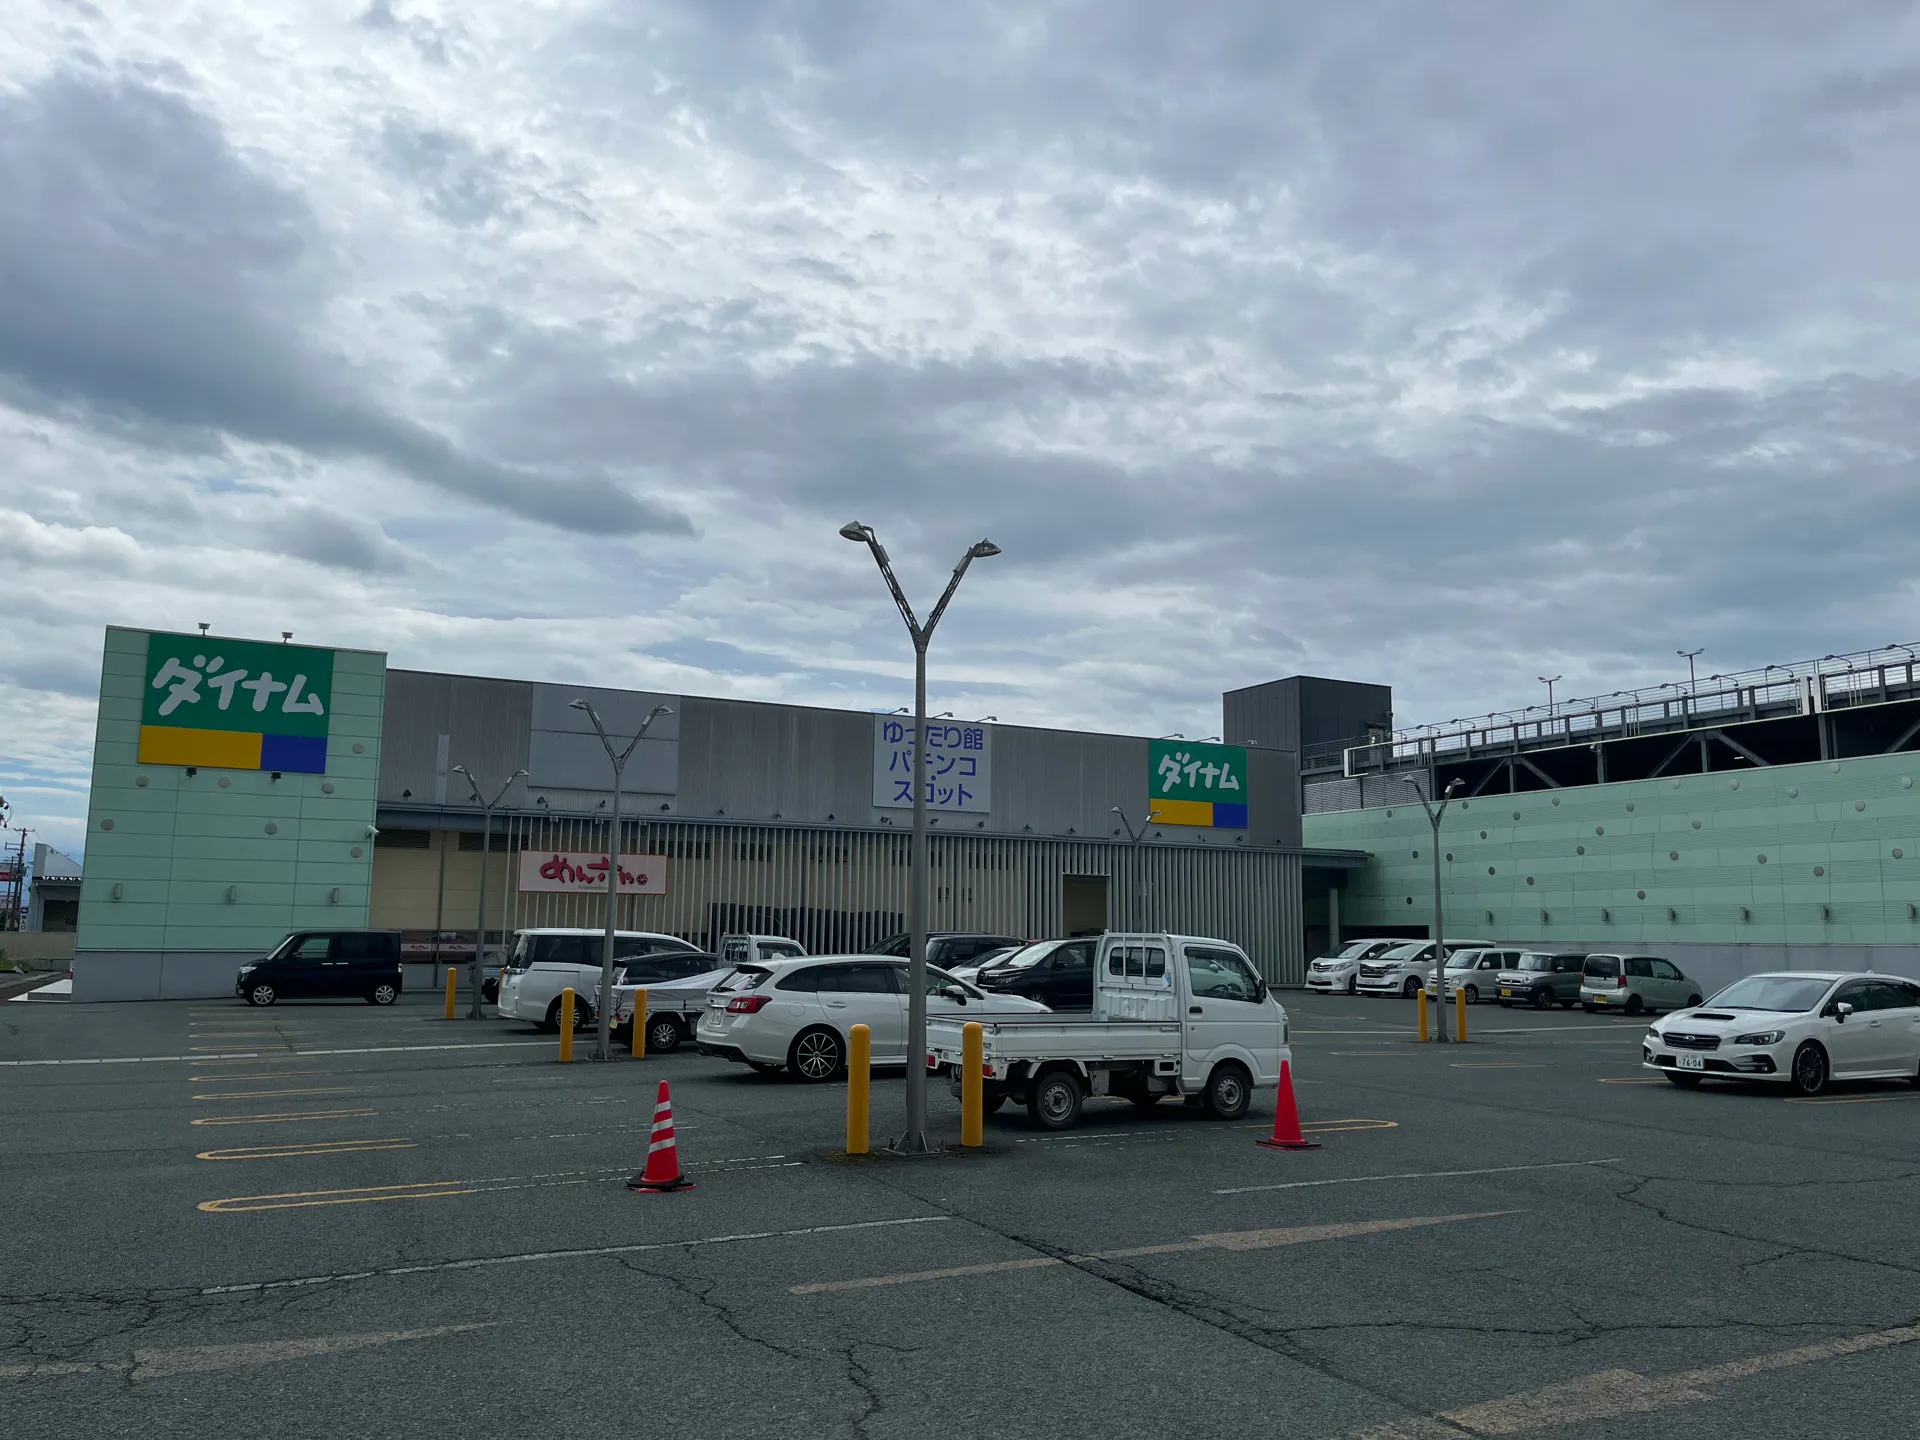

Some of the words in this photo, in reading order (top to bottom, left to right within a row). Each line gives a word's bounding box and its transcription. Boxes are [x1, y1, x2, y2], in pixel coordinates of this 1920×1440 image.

[152, 654, 324, 716] ダイナム
[1157, 751, 1240, 793] ダイナム
